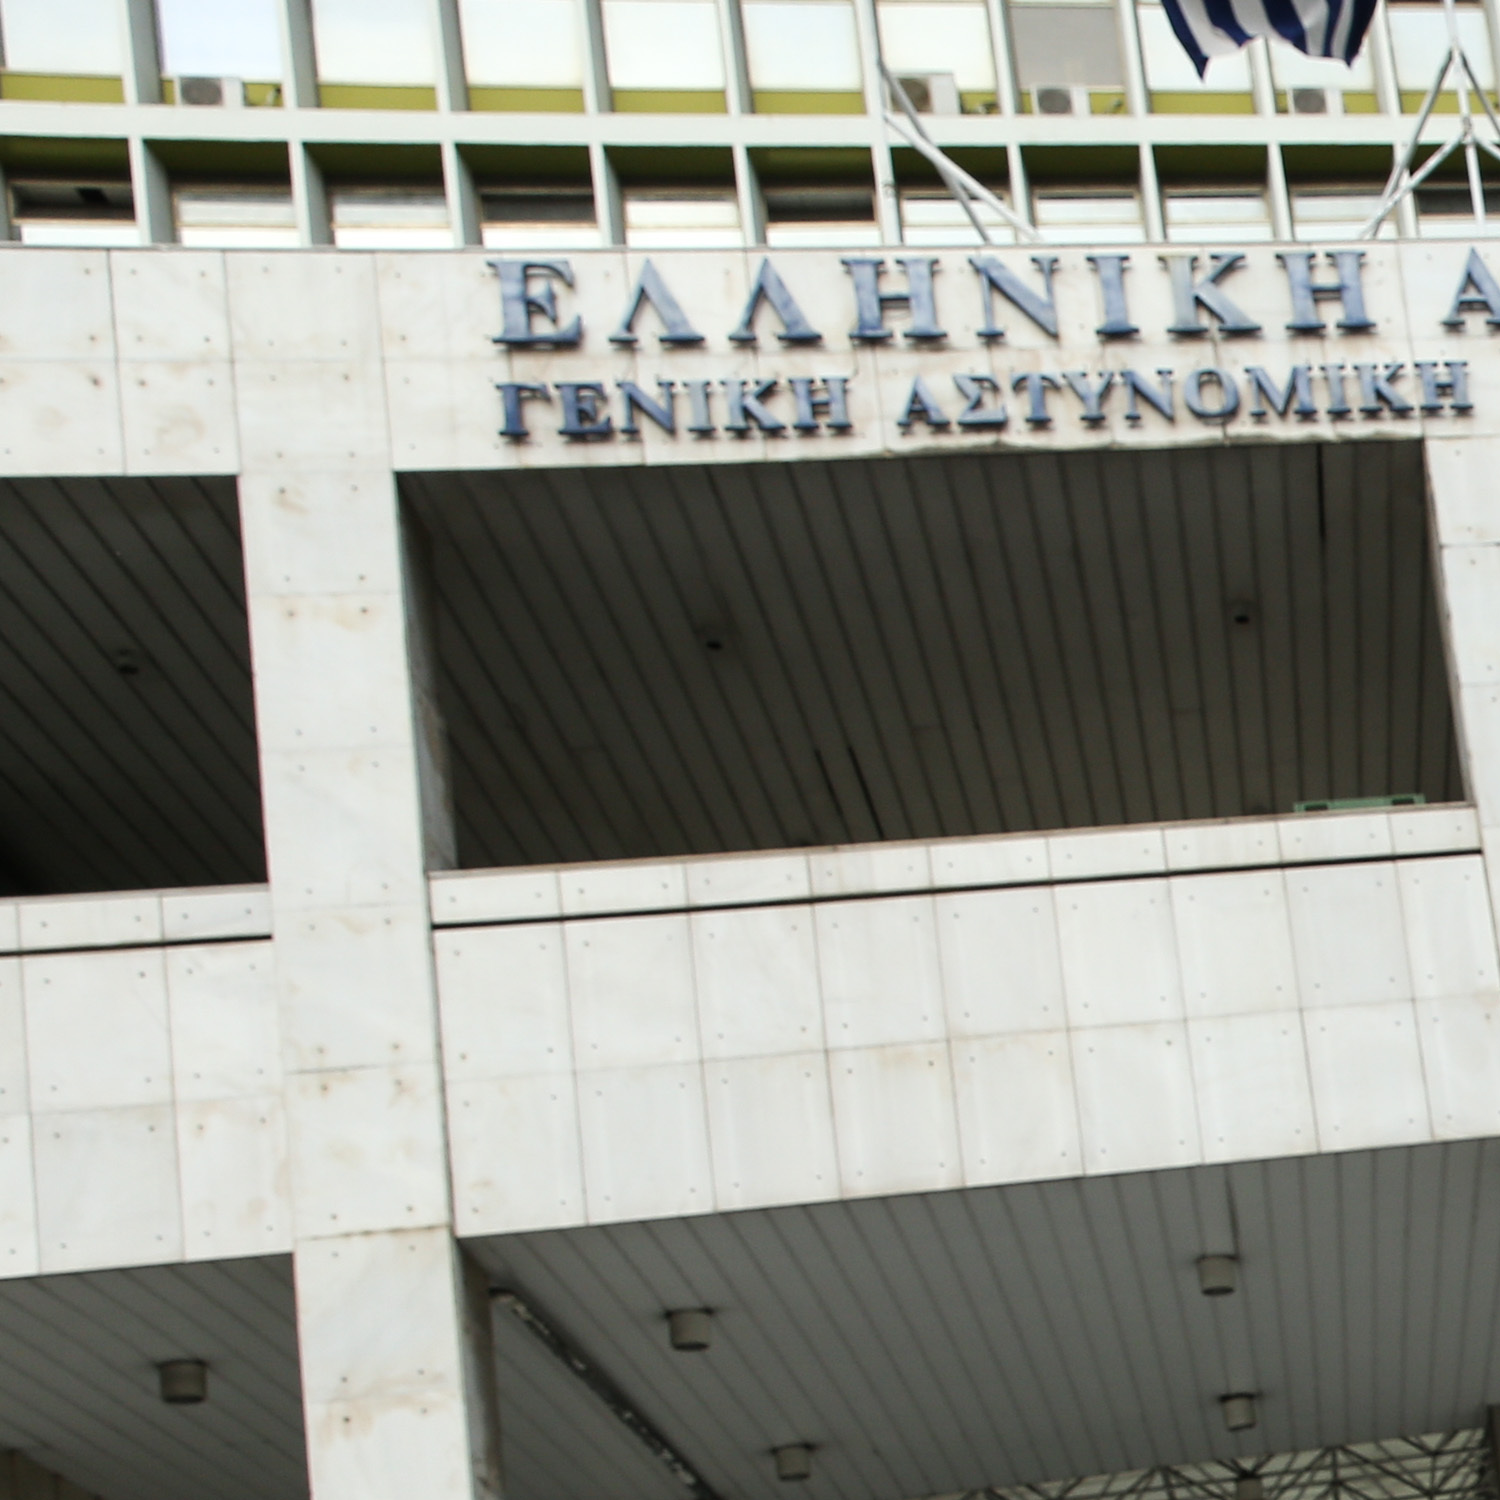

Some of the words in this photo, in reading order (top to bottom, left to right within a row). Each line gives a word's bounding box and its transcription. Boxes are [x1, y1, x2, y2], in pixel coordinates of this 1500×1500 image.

[486, 250, 1379, 349] ΕΛΛΗΝΙΚΗ
[494, 377, 853, 441] ΓΕΝΙΚΗ
[898, 361, 1474, 434] ΑΣΤΥΝΟΜΙΚΗ
